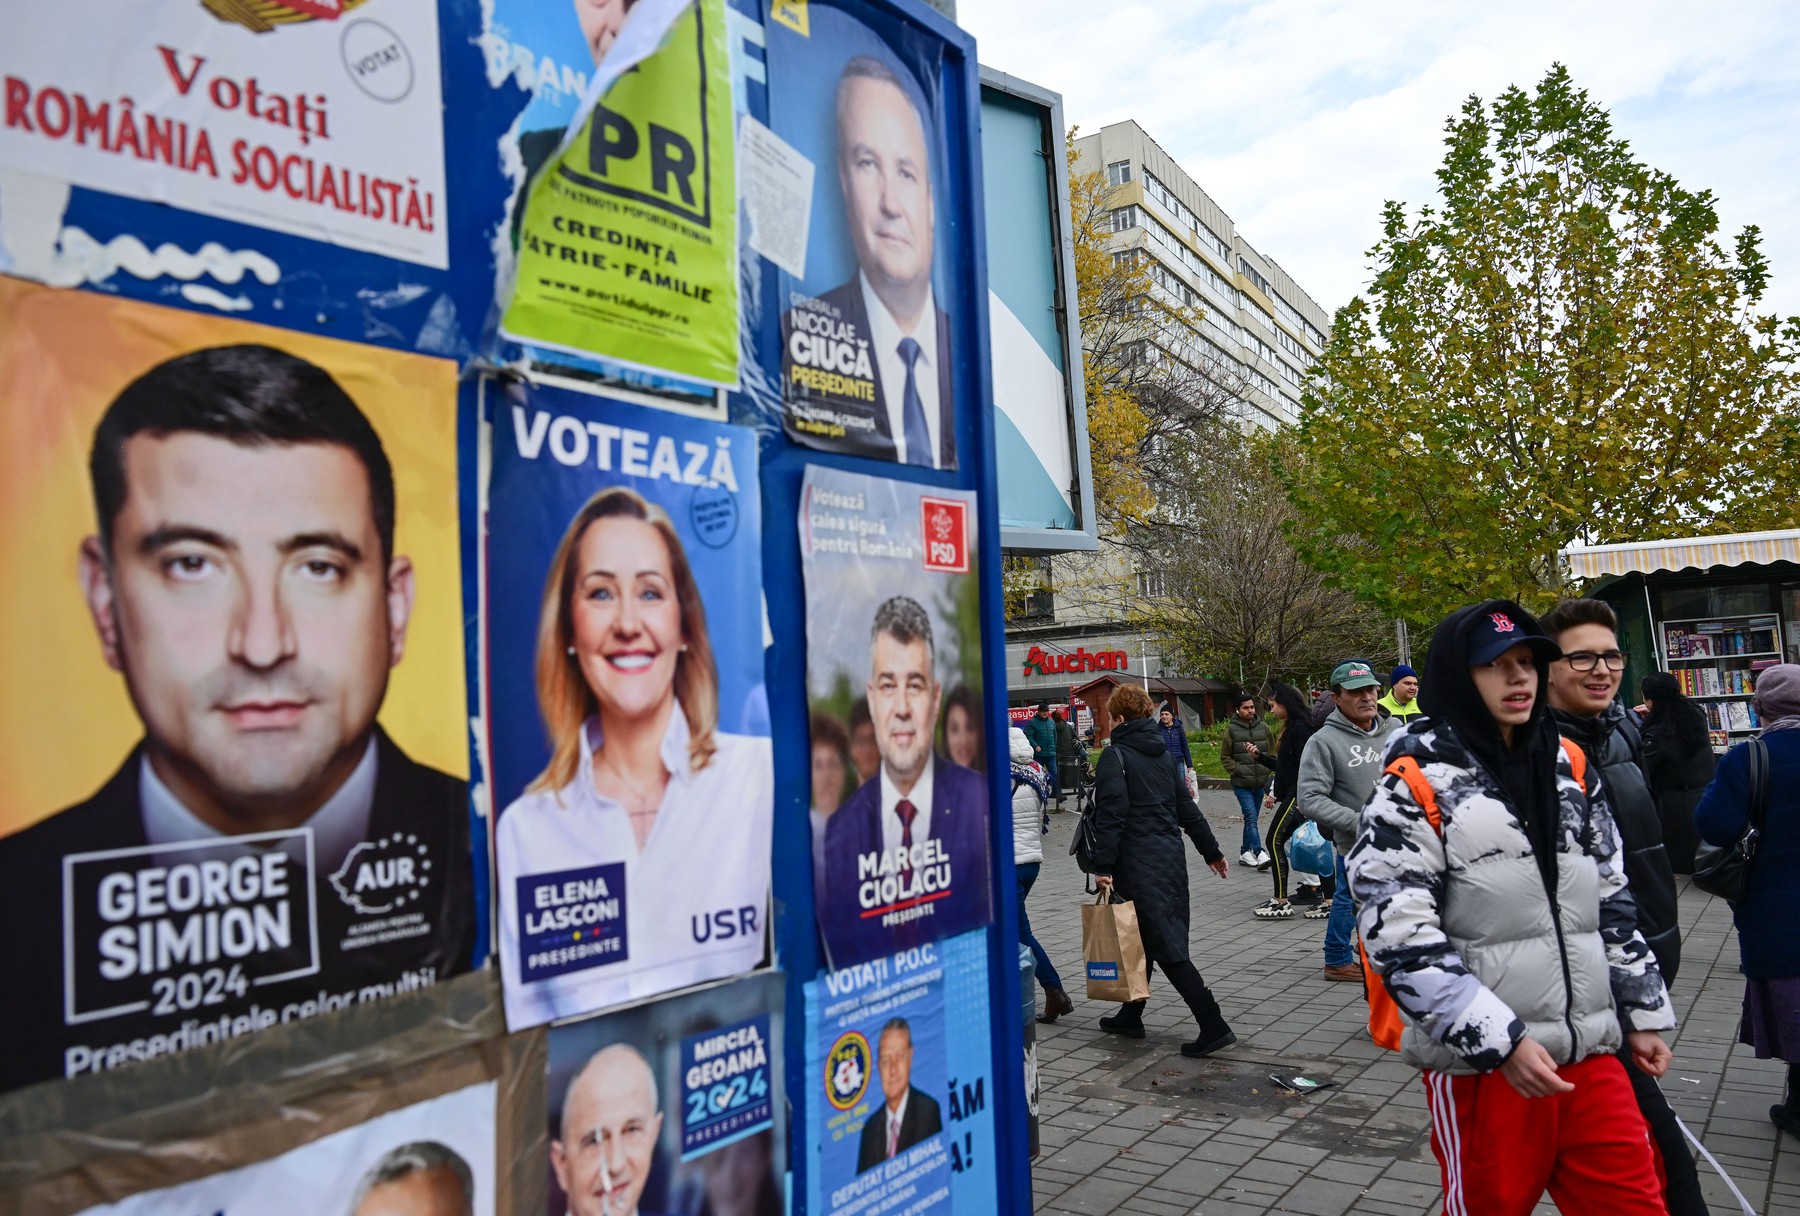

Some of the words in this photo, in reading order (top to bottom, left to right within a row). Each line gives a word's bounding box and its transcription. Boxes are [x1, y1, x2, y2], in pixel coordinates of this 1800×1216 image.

[156, 44, 330, 146] Votați
[3, 74, 219, 178] ROMÂNIA
[231, 138, 435, 233] SOCIALISTĂ!
[790, 309, 856, 344] NICOLAE
[789, 330, 874, 380] CIUCĂ
[790, 364, 876, 402] PREȘEDINTE
[511, 406, 739, 492] VOTEAZĂ
[812, 488, 865, 511] Votează
[930, 541, 956, 565] PSD
[1023, 646, 1128, 676] Auchan
[354, 857, 416, 892] AUR
[858, 838, 950, 881] MARCEL
[98, 851, 289, 921] GEORGE
[534, 877, 609, 909] ELENA
[858, 862, 951, 909] CIOLACU
[525, 897, 620, 936] LASCONI
[692, 905, 758, 944] USR
[98, 901, 291, 981] SIMION
[527, 936, 621, 970] PREȘEDINTE
[151, 964, 250, 1017] 2024
[825, 957, 889, 998] VOTAȚI
[694, 1025, 759, 1062] MIRCEA
[686, 1038, 767, 1090] GEOANĂ
[686, 1068, 768, 1125] 2024
[831, 1168, 885, 1208] DEPUTAT
